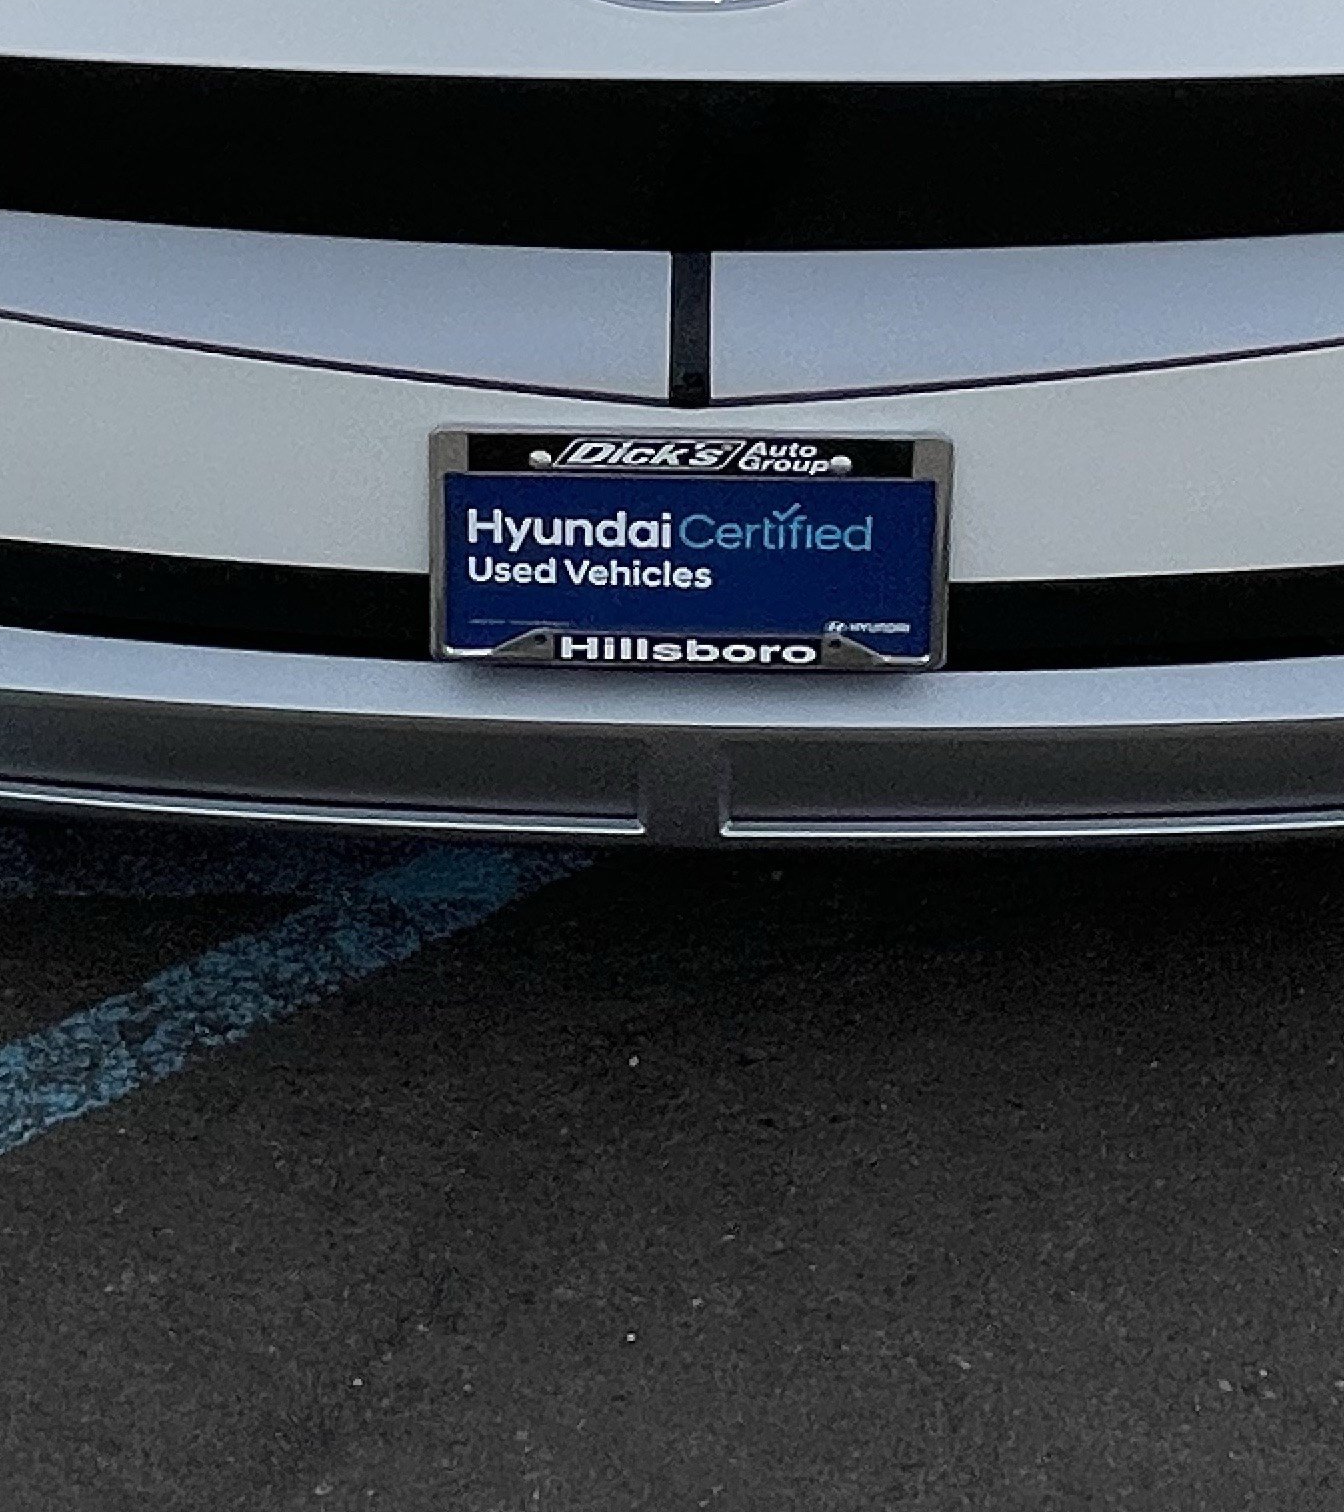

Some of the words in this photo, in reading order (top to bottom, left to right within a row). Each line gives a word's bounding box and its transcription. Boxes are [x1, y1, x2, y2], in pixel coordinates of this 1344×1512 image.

[749, 441, 818, 458] Auto
[737, 455, 830, 476] Group
[467, 508, 672, 552] Hyundai
[678, 508, 874, 552] Certified
[467, 557, 558, 584] Used
[563, 558, 713, 589] Vehicles
[560, 635, 817, 665] Hillsboro
